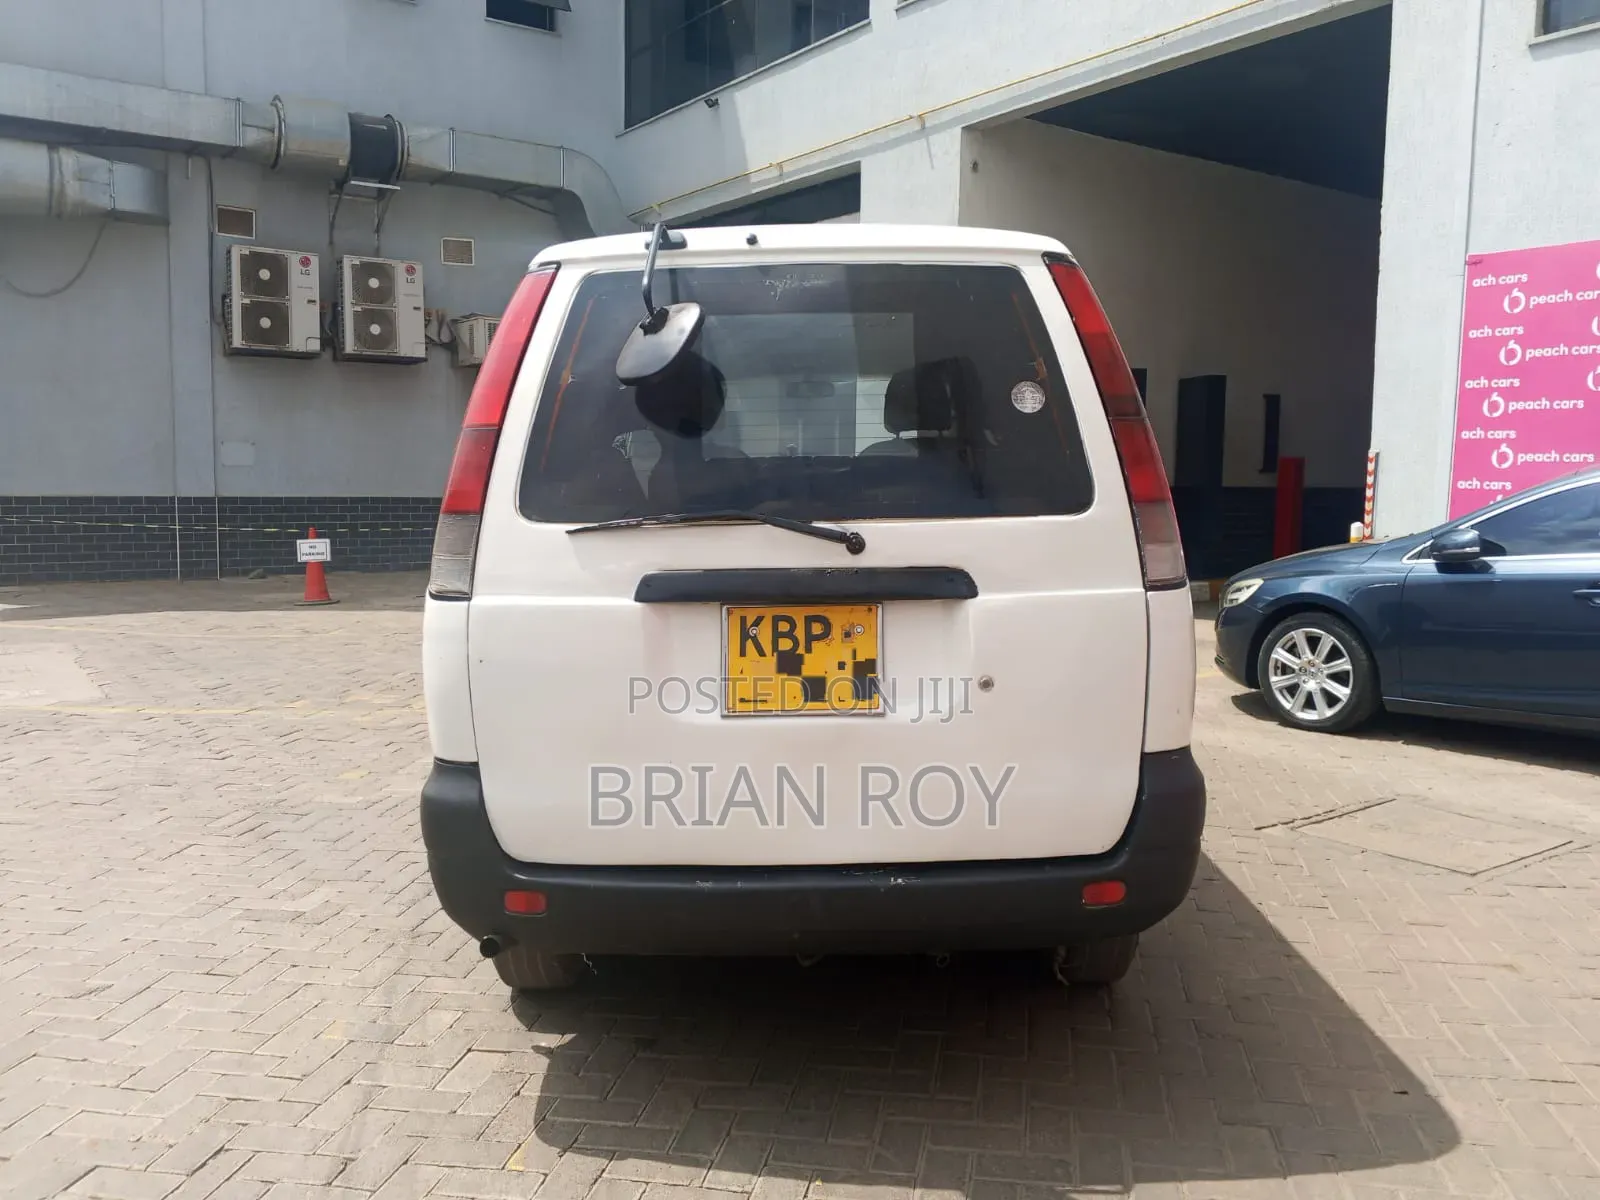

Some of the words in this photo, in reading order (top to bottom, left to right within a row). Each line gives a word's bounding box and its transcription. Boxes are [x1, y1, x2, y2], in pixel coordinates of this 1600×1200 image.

[1472, 274, 1496, 287] ach
[1498, 273, 1528, 285] cars
[1530, 289, 1573, 309] peach
[1575, 290, 1600, 301] car
[1468, 325, 1492, 338] ach
[1495, 325, 1524, 337] cars
[1525, 343, 1569, 361] peach
[1465, 376, 1488, 389] ach
[1491, 378, 1520, 387] cars
[1508, 397, 1550, 414] peach
[1553, 399, 1584, 409] cars
[1461, 427, 1485, 439] ach
[1487, 430, 1517, 439] cars
[1517, 450, 1560, 465] peach
[1562, 452, 1594, 462] cars
[1457, 477, 1481, 489] ach
[1483, 480, 1512, 490] cars
[738, 614, 832, 658] KBP
